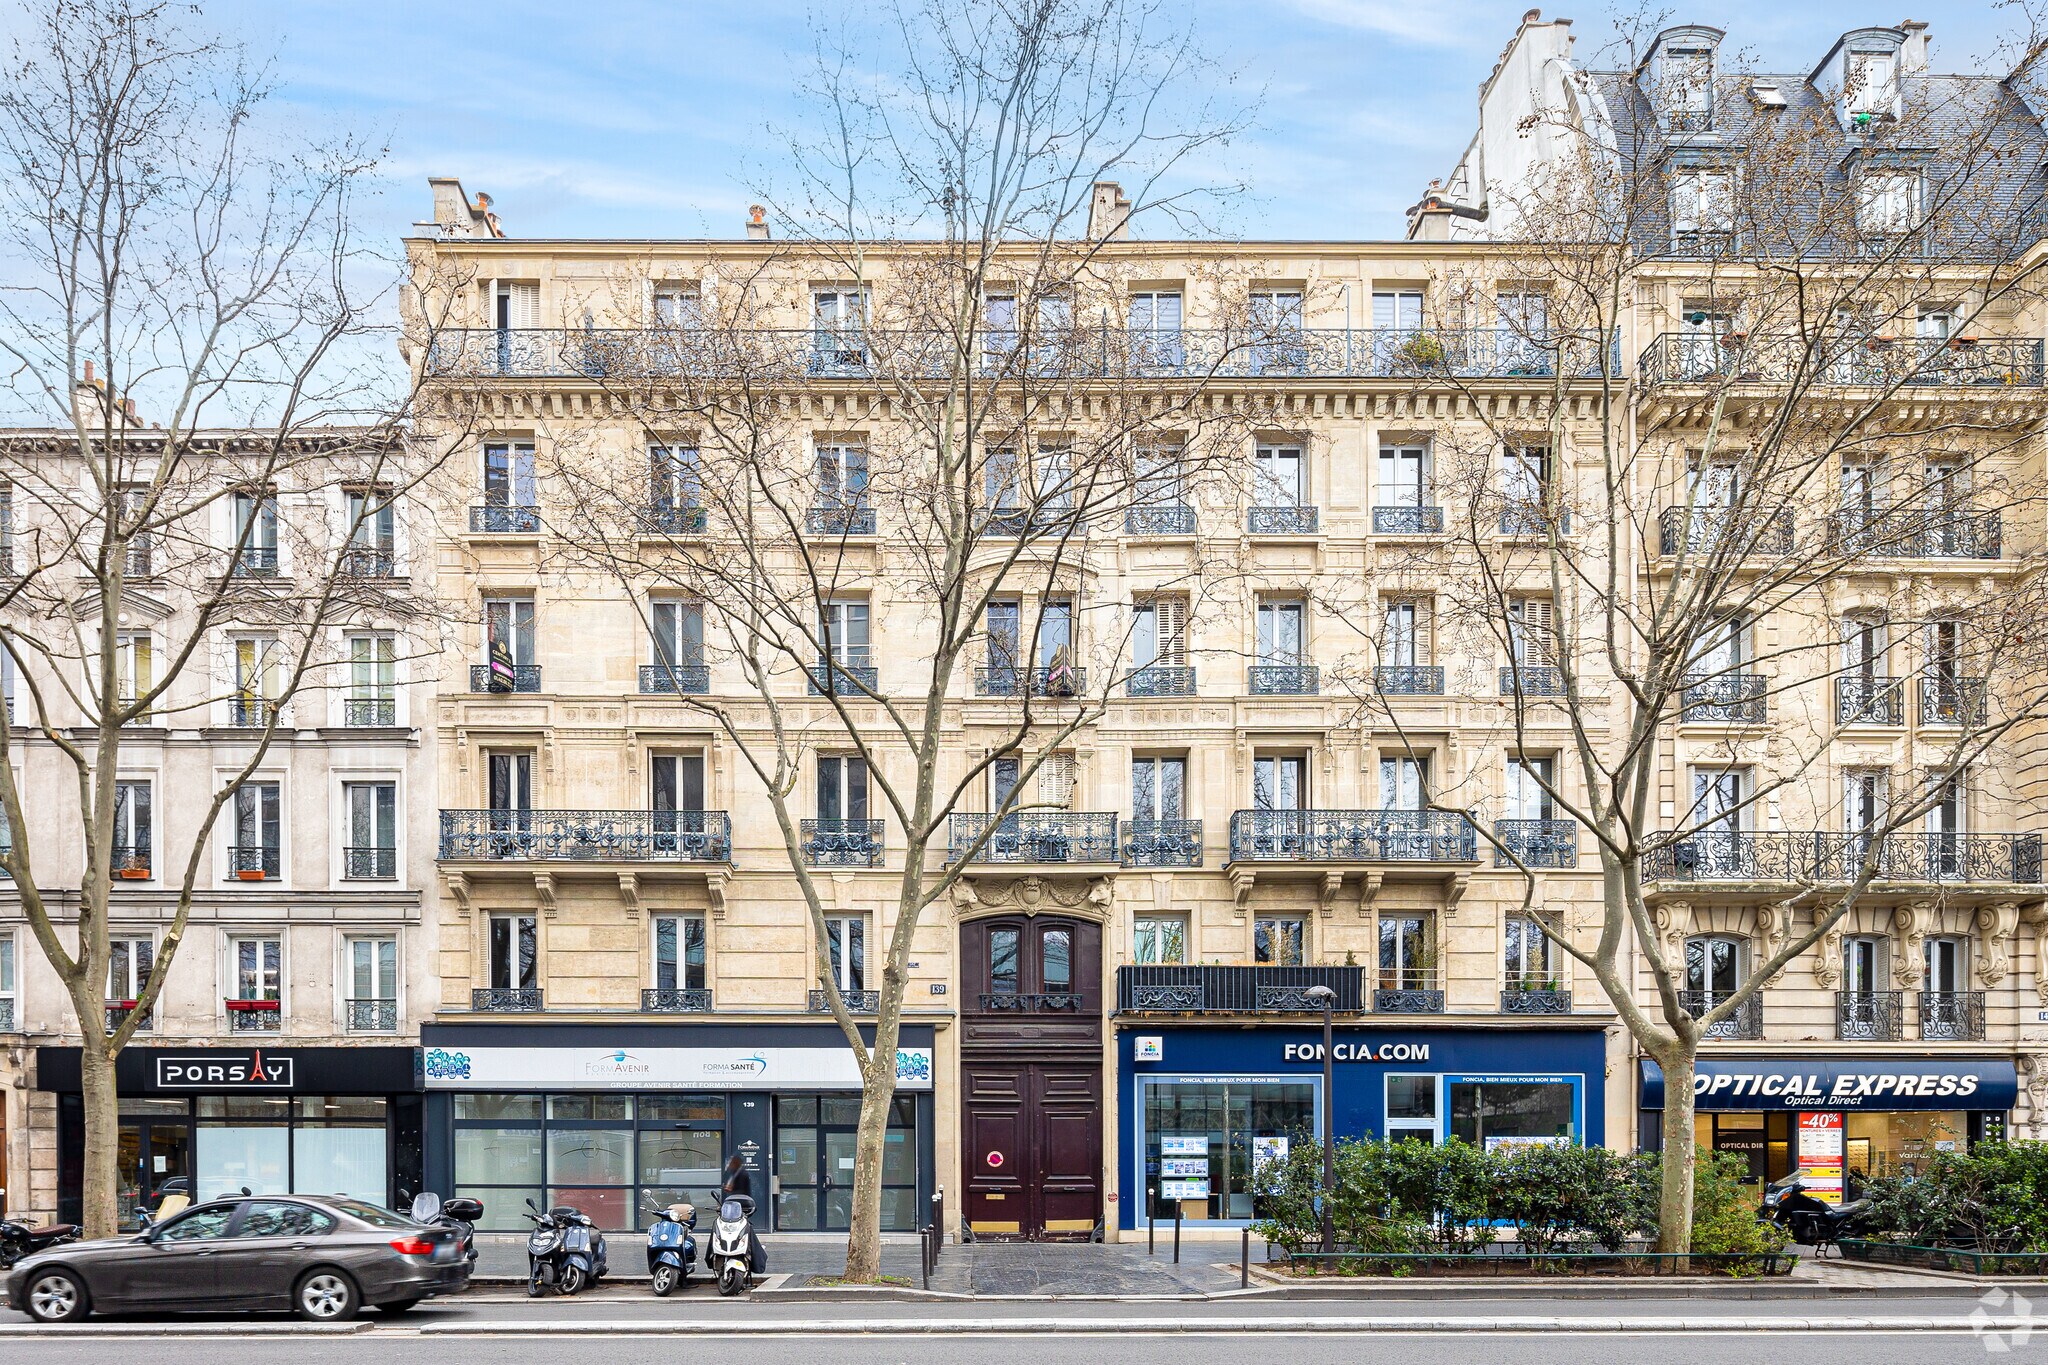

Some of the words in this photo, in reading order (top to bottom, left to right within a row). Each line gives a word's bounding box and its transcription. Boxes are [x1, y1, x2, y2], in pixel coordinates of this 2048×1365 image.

[932, 985, 945, 994] 139
[703, 1063, 730, 1071] FORMA
[730, 1062, 755, 1071] SANTÉ
[672, 1080, 696, 1088] SANTÉ
[1694, 1074, 1823, 1096] OPTICAL
[1830, 1074, 1979, 1096] EXPRESS
[1784, 1095, 1824, 1106] Optical
[1828, 1095, 1862, 1105] Direct
[1802, 1113, 1839, 1128] -40%
